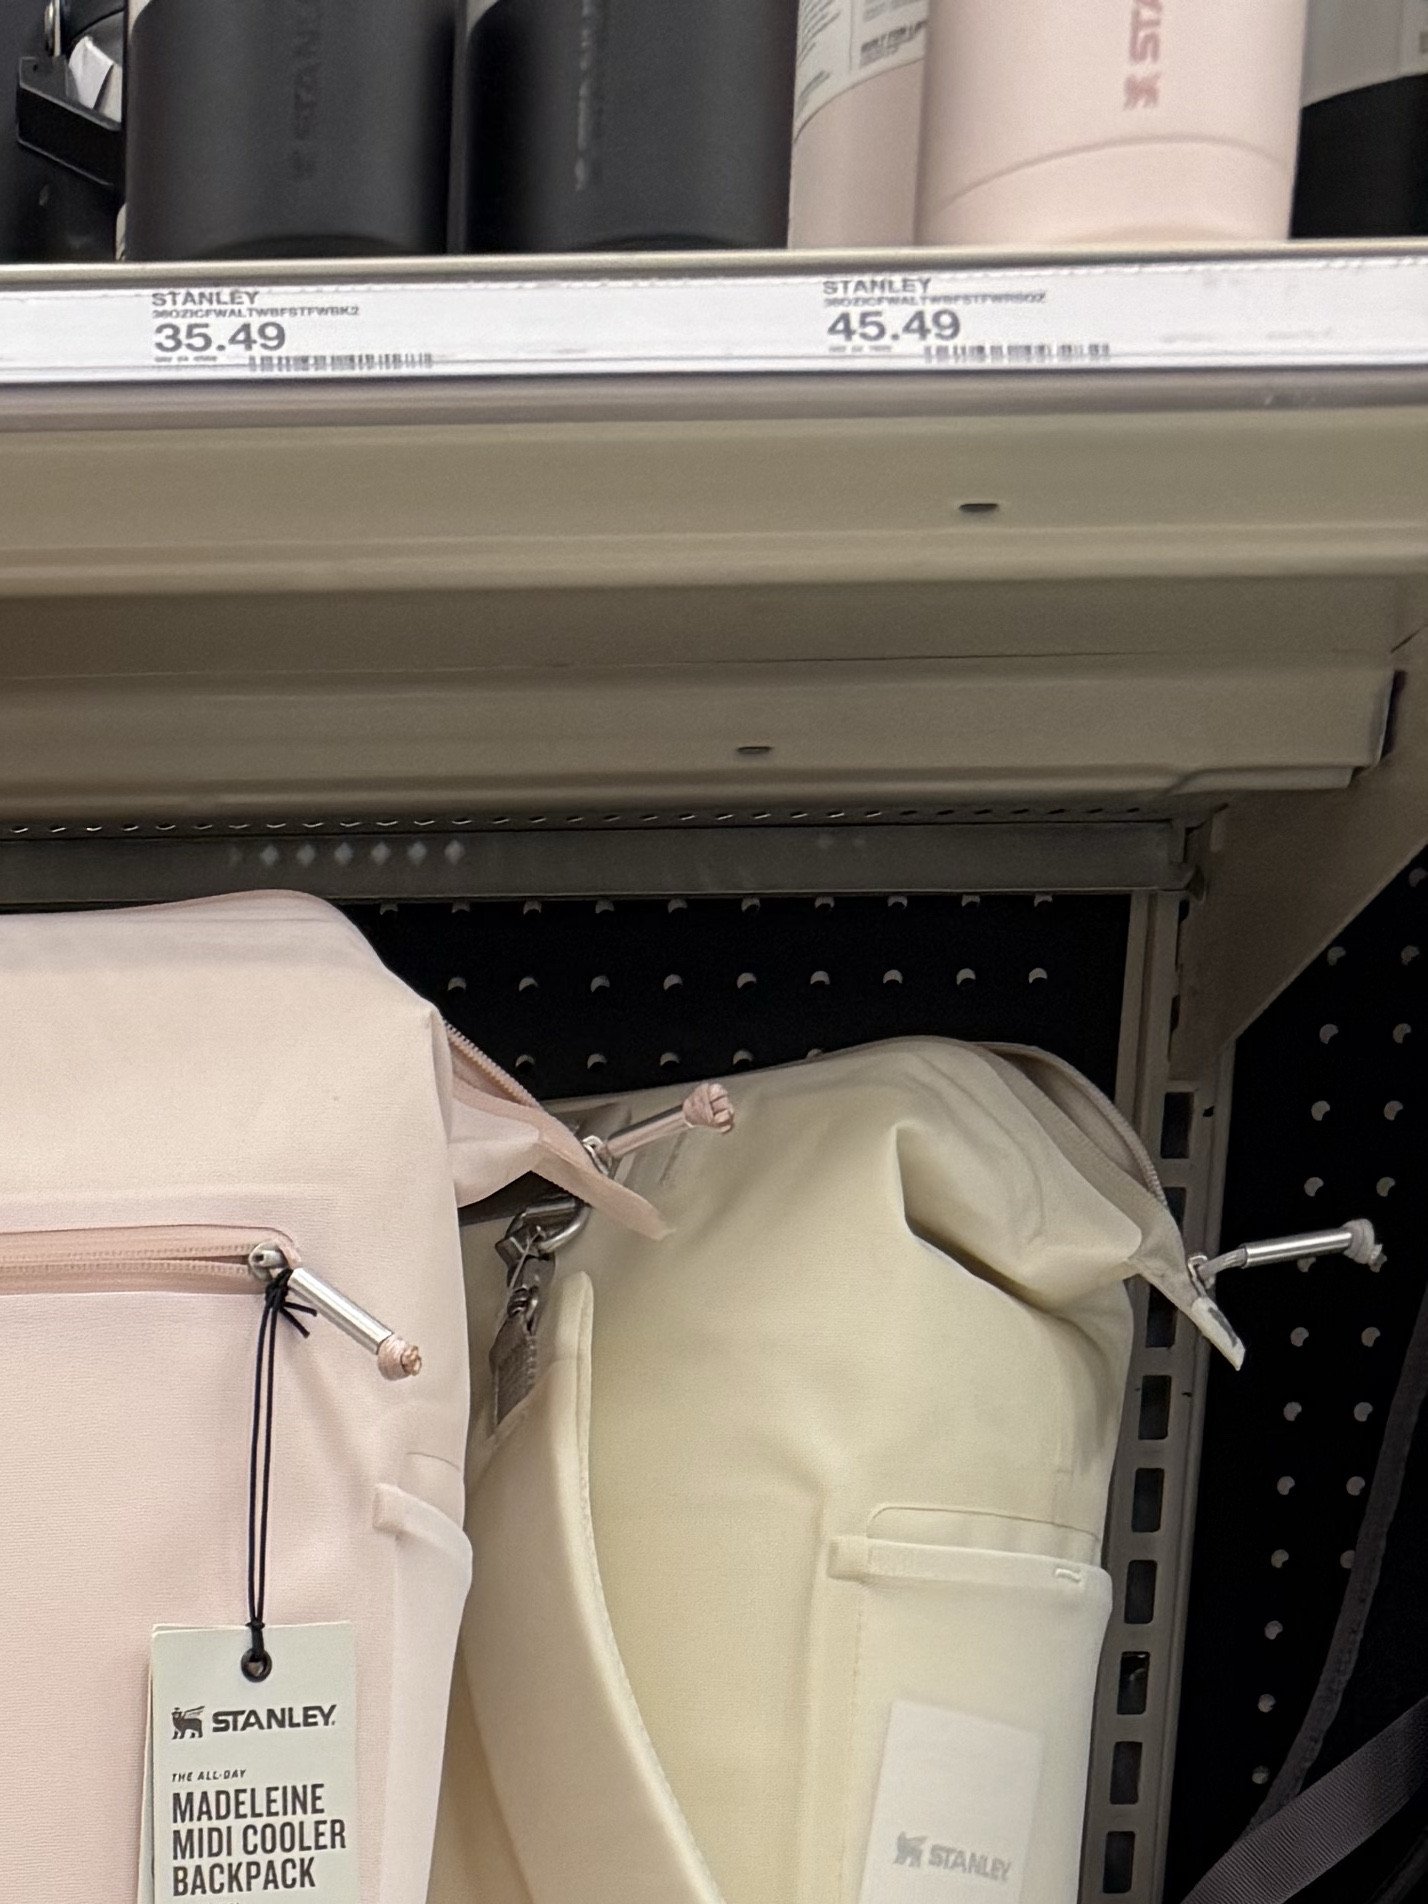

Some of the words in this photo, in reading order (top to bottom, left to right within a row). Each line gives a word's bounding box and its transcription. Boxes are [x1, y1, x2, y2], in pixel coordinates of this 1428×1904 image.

[151, 291, 260, 307] STANLEY
[823, 278, 932, 295] STANLEY
[154, 322, 286, 352] 35.49
[827, 309, 961, 342] 45.49
[211, 1704, 338, 1733] STANLEY
[171, 1770, 194, 1783] THE
[171, 1783, 326, 1824] MADELEINE
[171, 1826, 233, 1860] MIDI
[242, 1819, 347, 1855] COOLER
[172, 1856, 316, 1897] BACKPACK
[928, 1843, 1012, 1883] STANLEY
